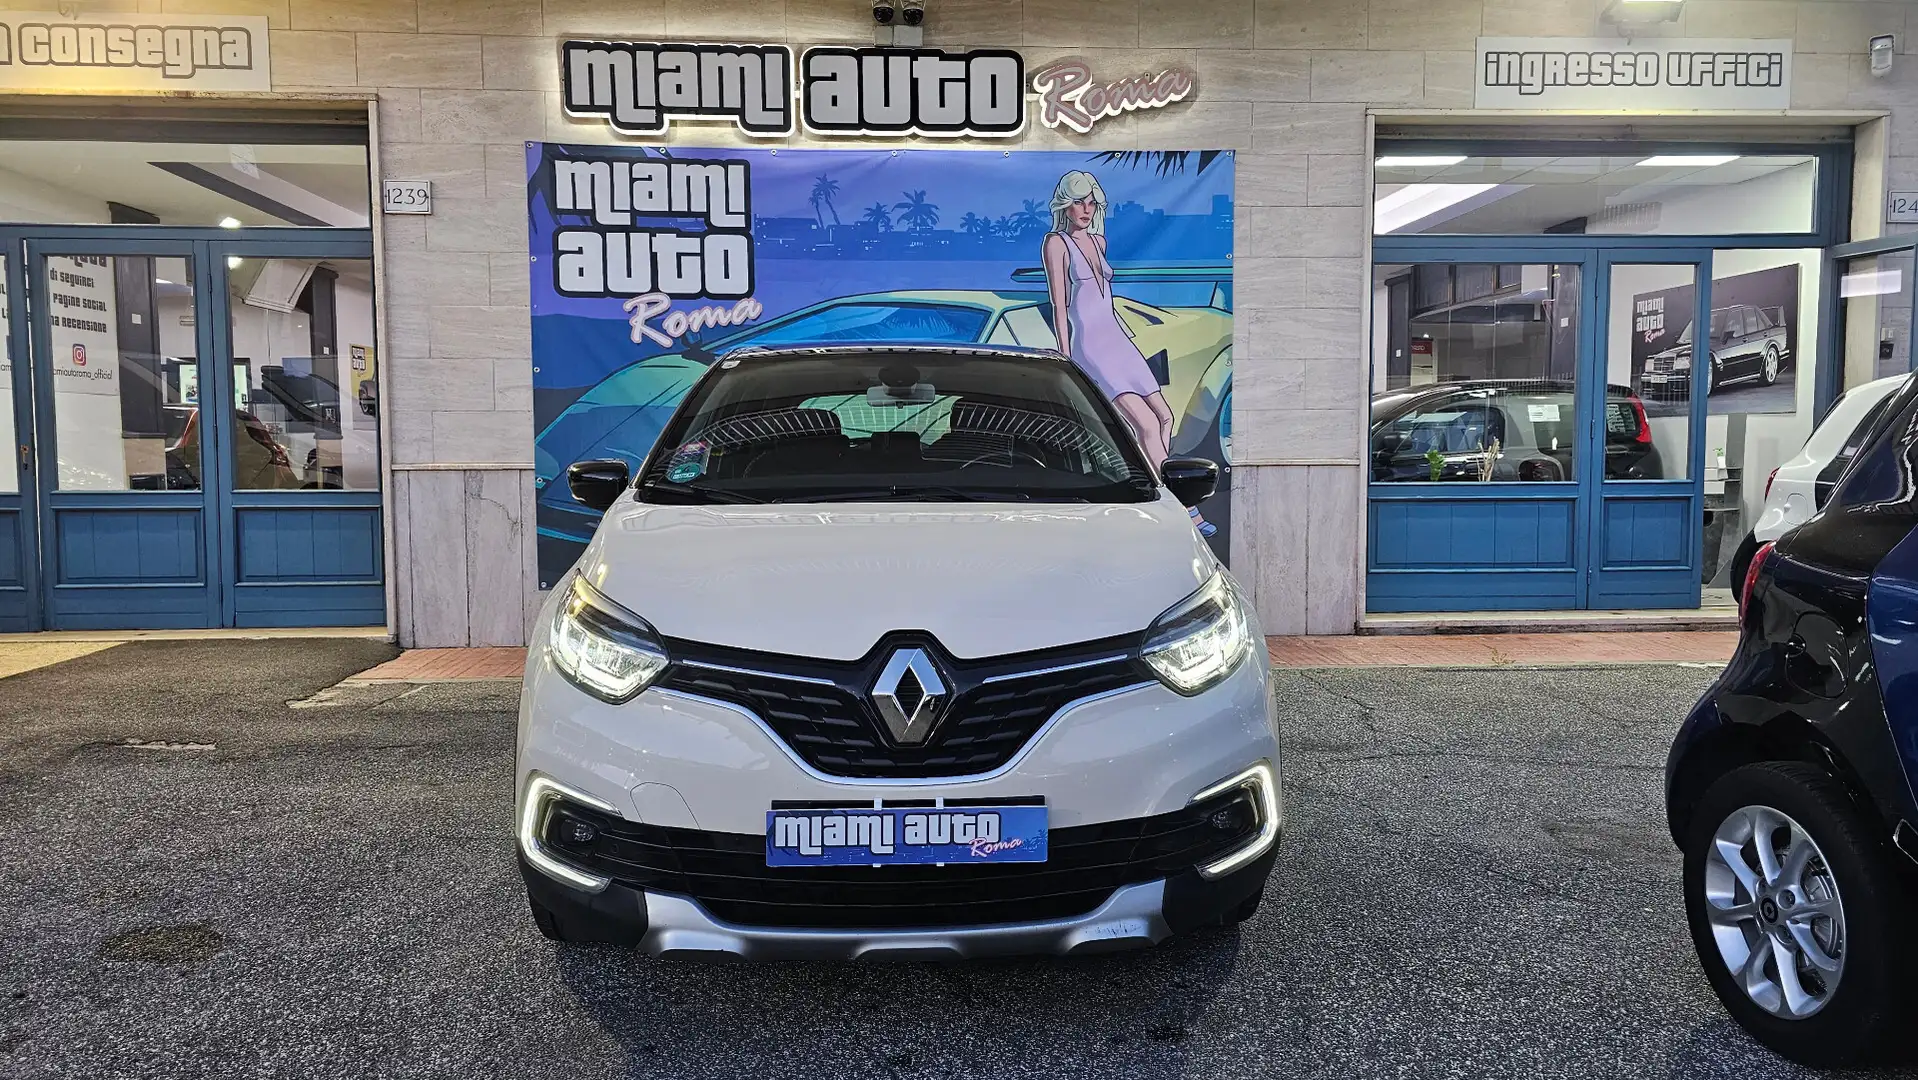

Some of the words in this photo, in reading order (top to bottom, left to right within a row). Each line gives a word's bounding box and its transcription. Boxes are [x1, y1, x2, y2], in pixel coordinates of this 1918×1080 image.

[18, 23, 253, 79] consegna
[1485, 52, 1660, 95] ingresso
[1033, 61, 1193, 132] Roma
[386, 187, 429, 206] 1239
[49, 267, 58, 281] di
[622, 291, 764, 348] Roma
[968, 836, 1022, 858] Roma
